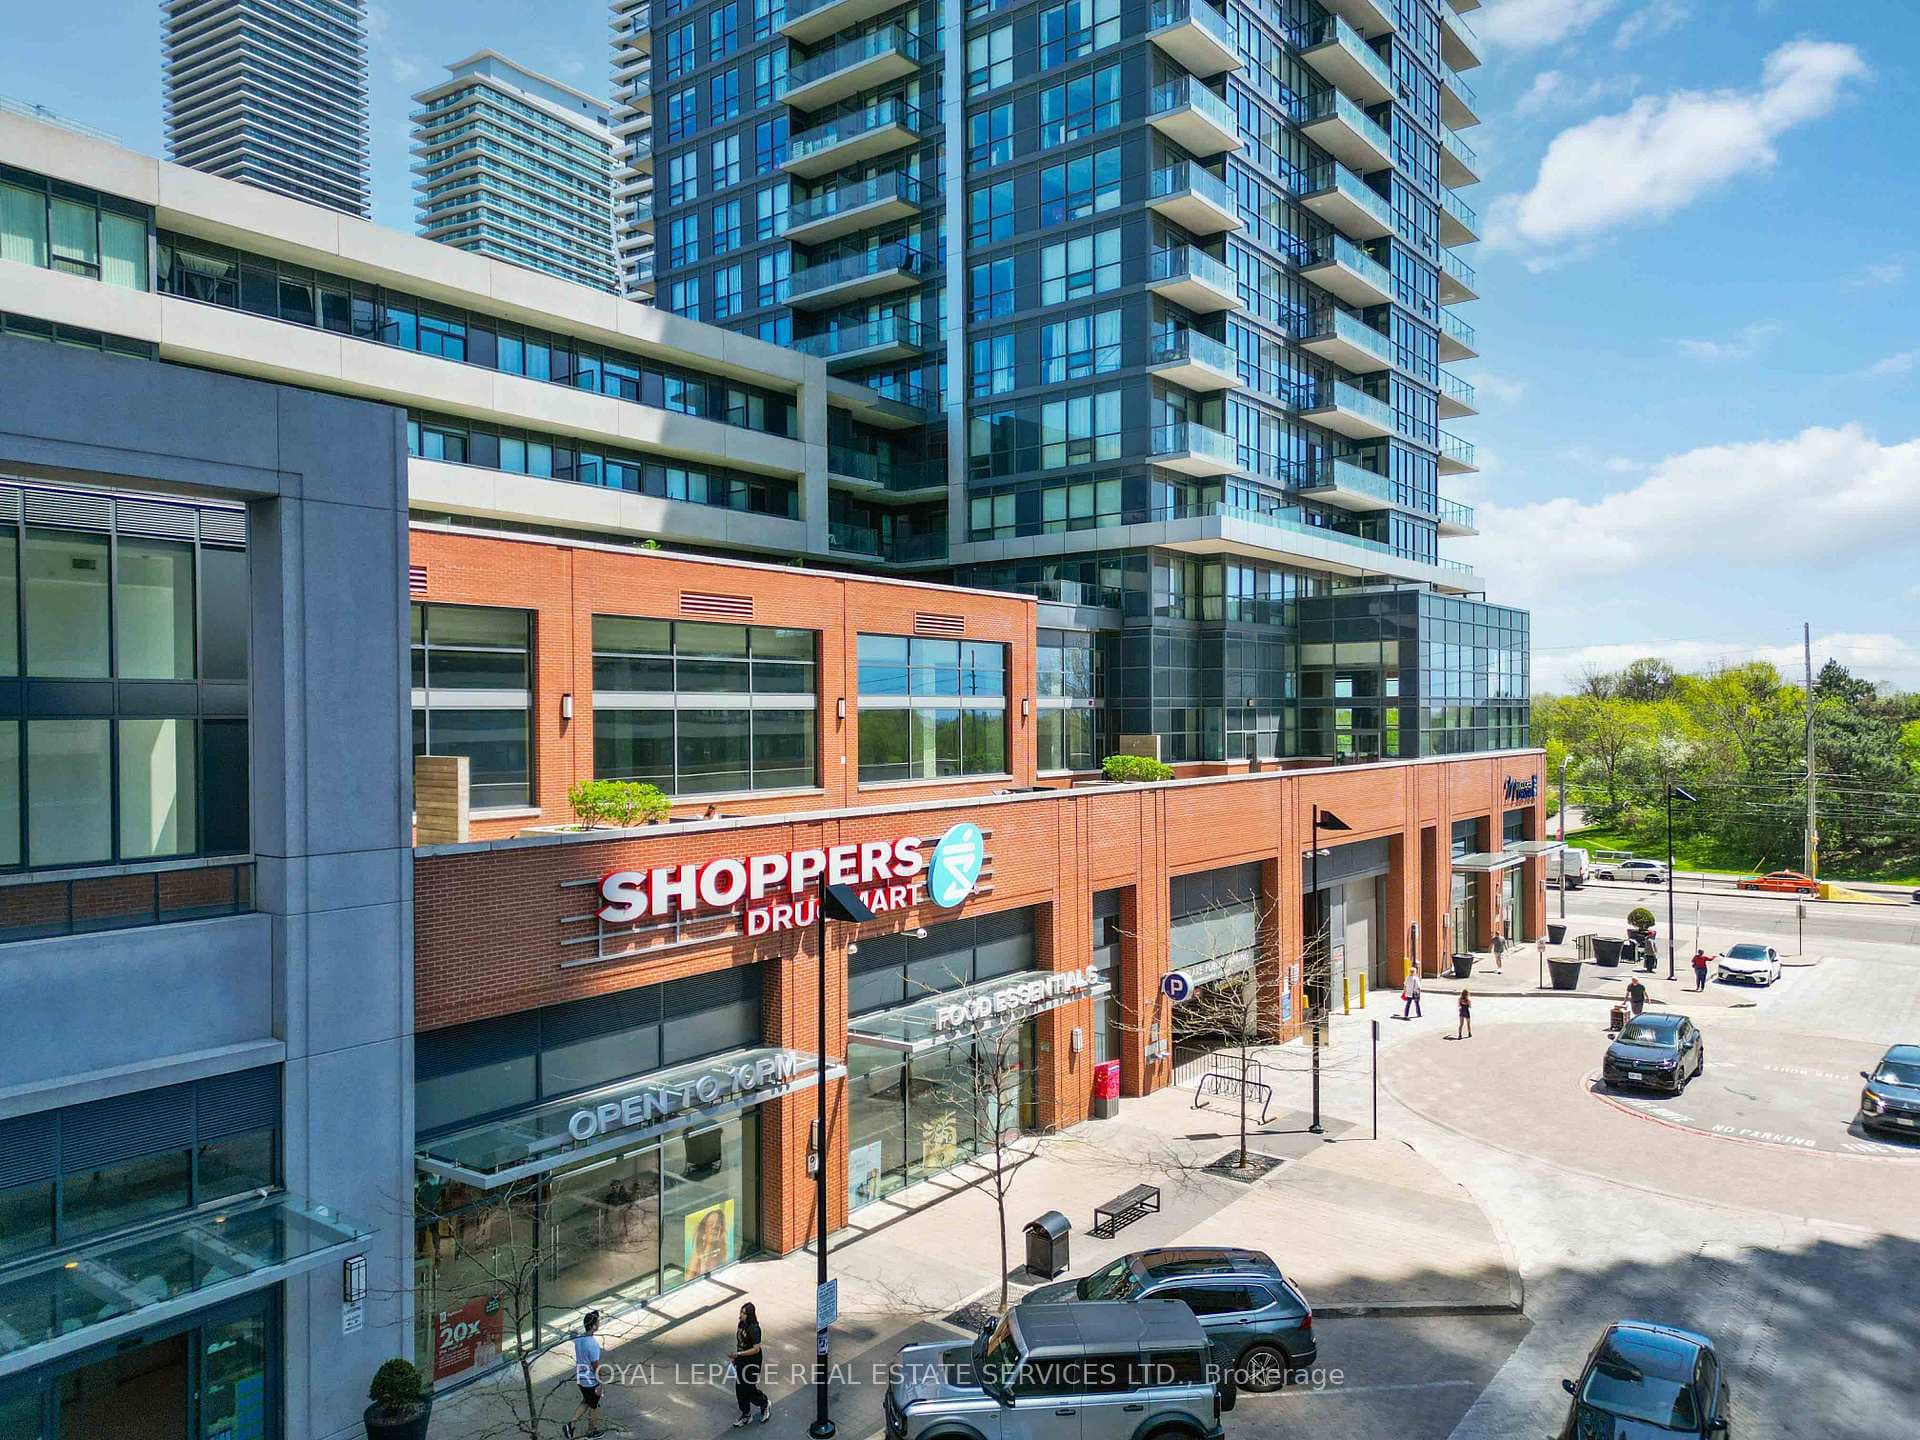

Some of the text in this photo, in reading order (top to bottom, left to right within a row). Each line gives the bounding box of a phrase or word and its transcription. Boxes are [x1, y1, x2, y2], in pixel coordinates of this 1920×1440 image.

[599, 836, 923, 922] SHOPPERS
[745, 899, 823, 936] DRU
[936, 965, 1098, 1030] FOOD ESSENTIALS
[1170, 979, 1184, 996] P
[568, 1052, 797, 1140] OPEN TO 10PM
[1712, 1124, 1816, 1147] NO PARKING
